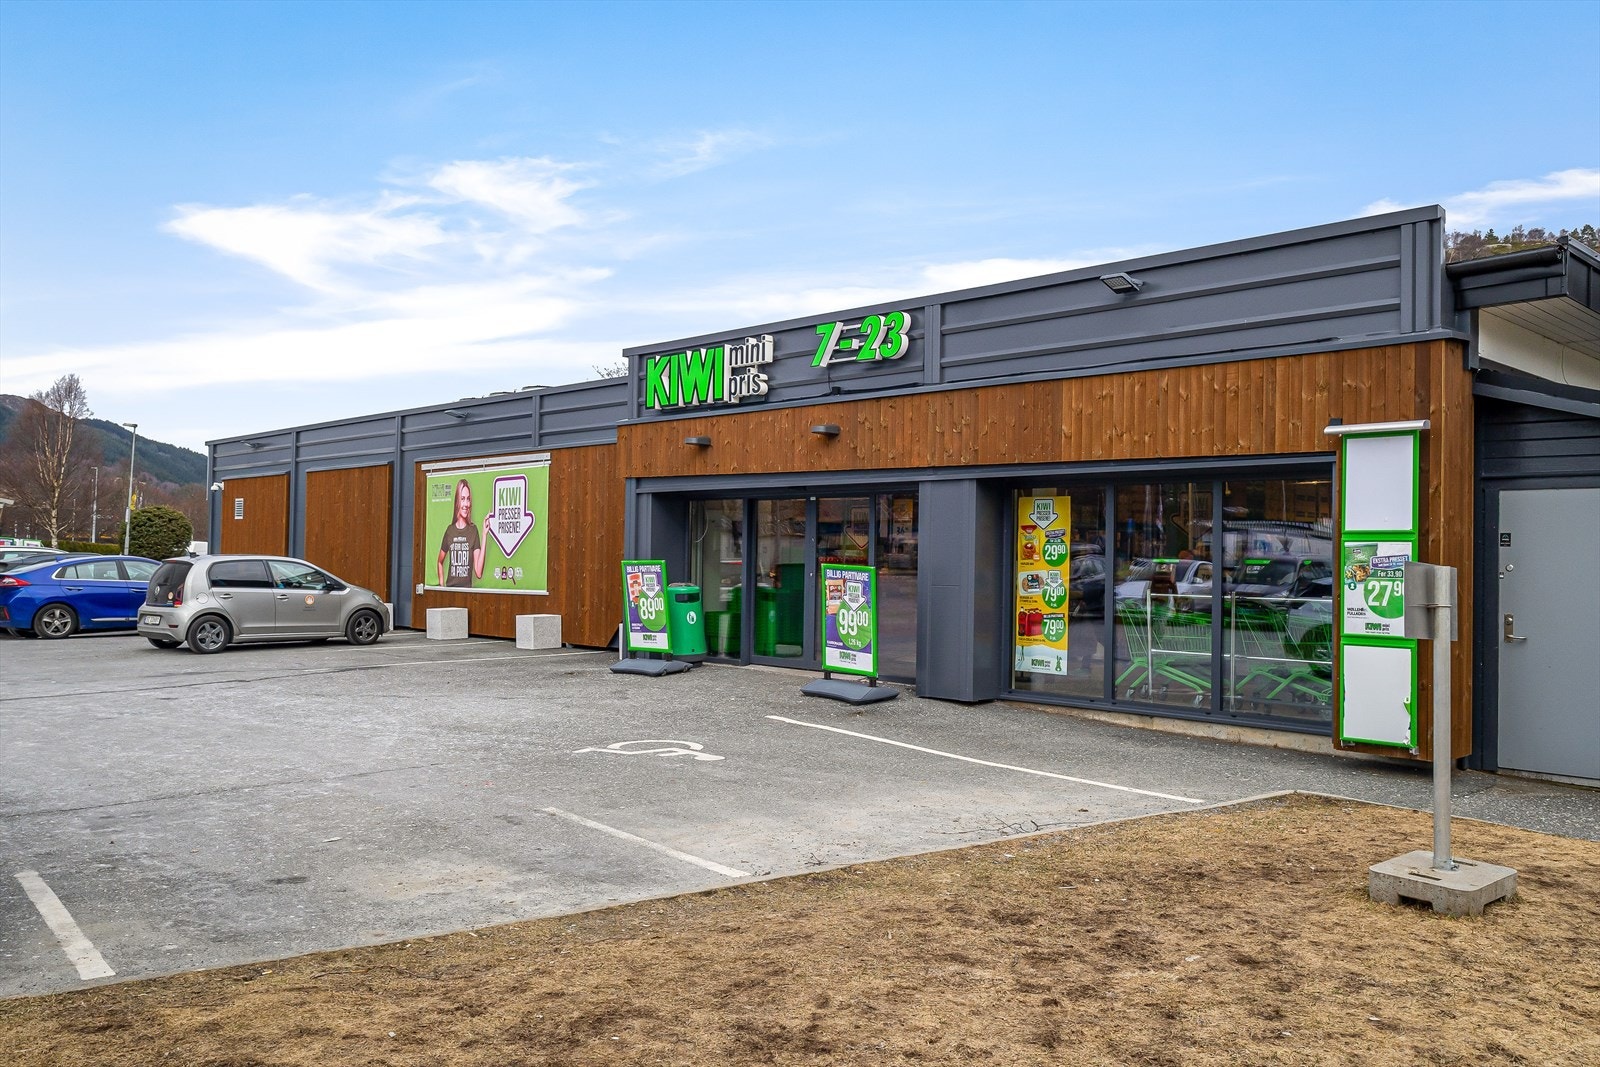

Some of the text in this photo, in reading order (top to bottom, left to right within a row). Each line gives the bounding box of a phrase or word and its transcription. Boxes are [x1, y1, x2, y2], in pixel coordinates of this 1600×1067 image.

[728, 335, 773, 367] mini
[810, 310, 909, 368] 7-23
[645, 345, 727, 410] KIWI
[728, 367, 767, 401] pris
[500, 488, 521, 506] KIWI
[1037, 503, 1051, 511] KIWI
[499, 508, 521, 520] PRESSER
[827, 570, 869, 581] BILLIG PARTIVARE
[1368, 581, 1404, 607] 279
